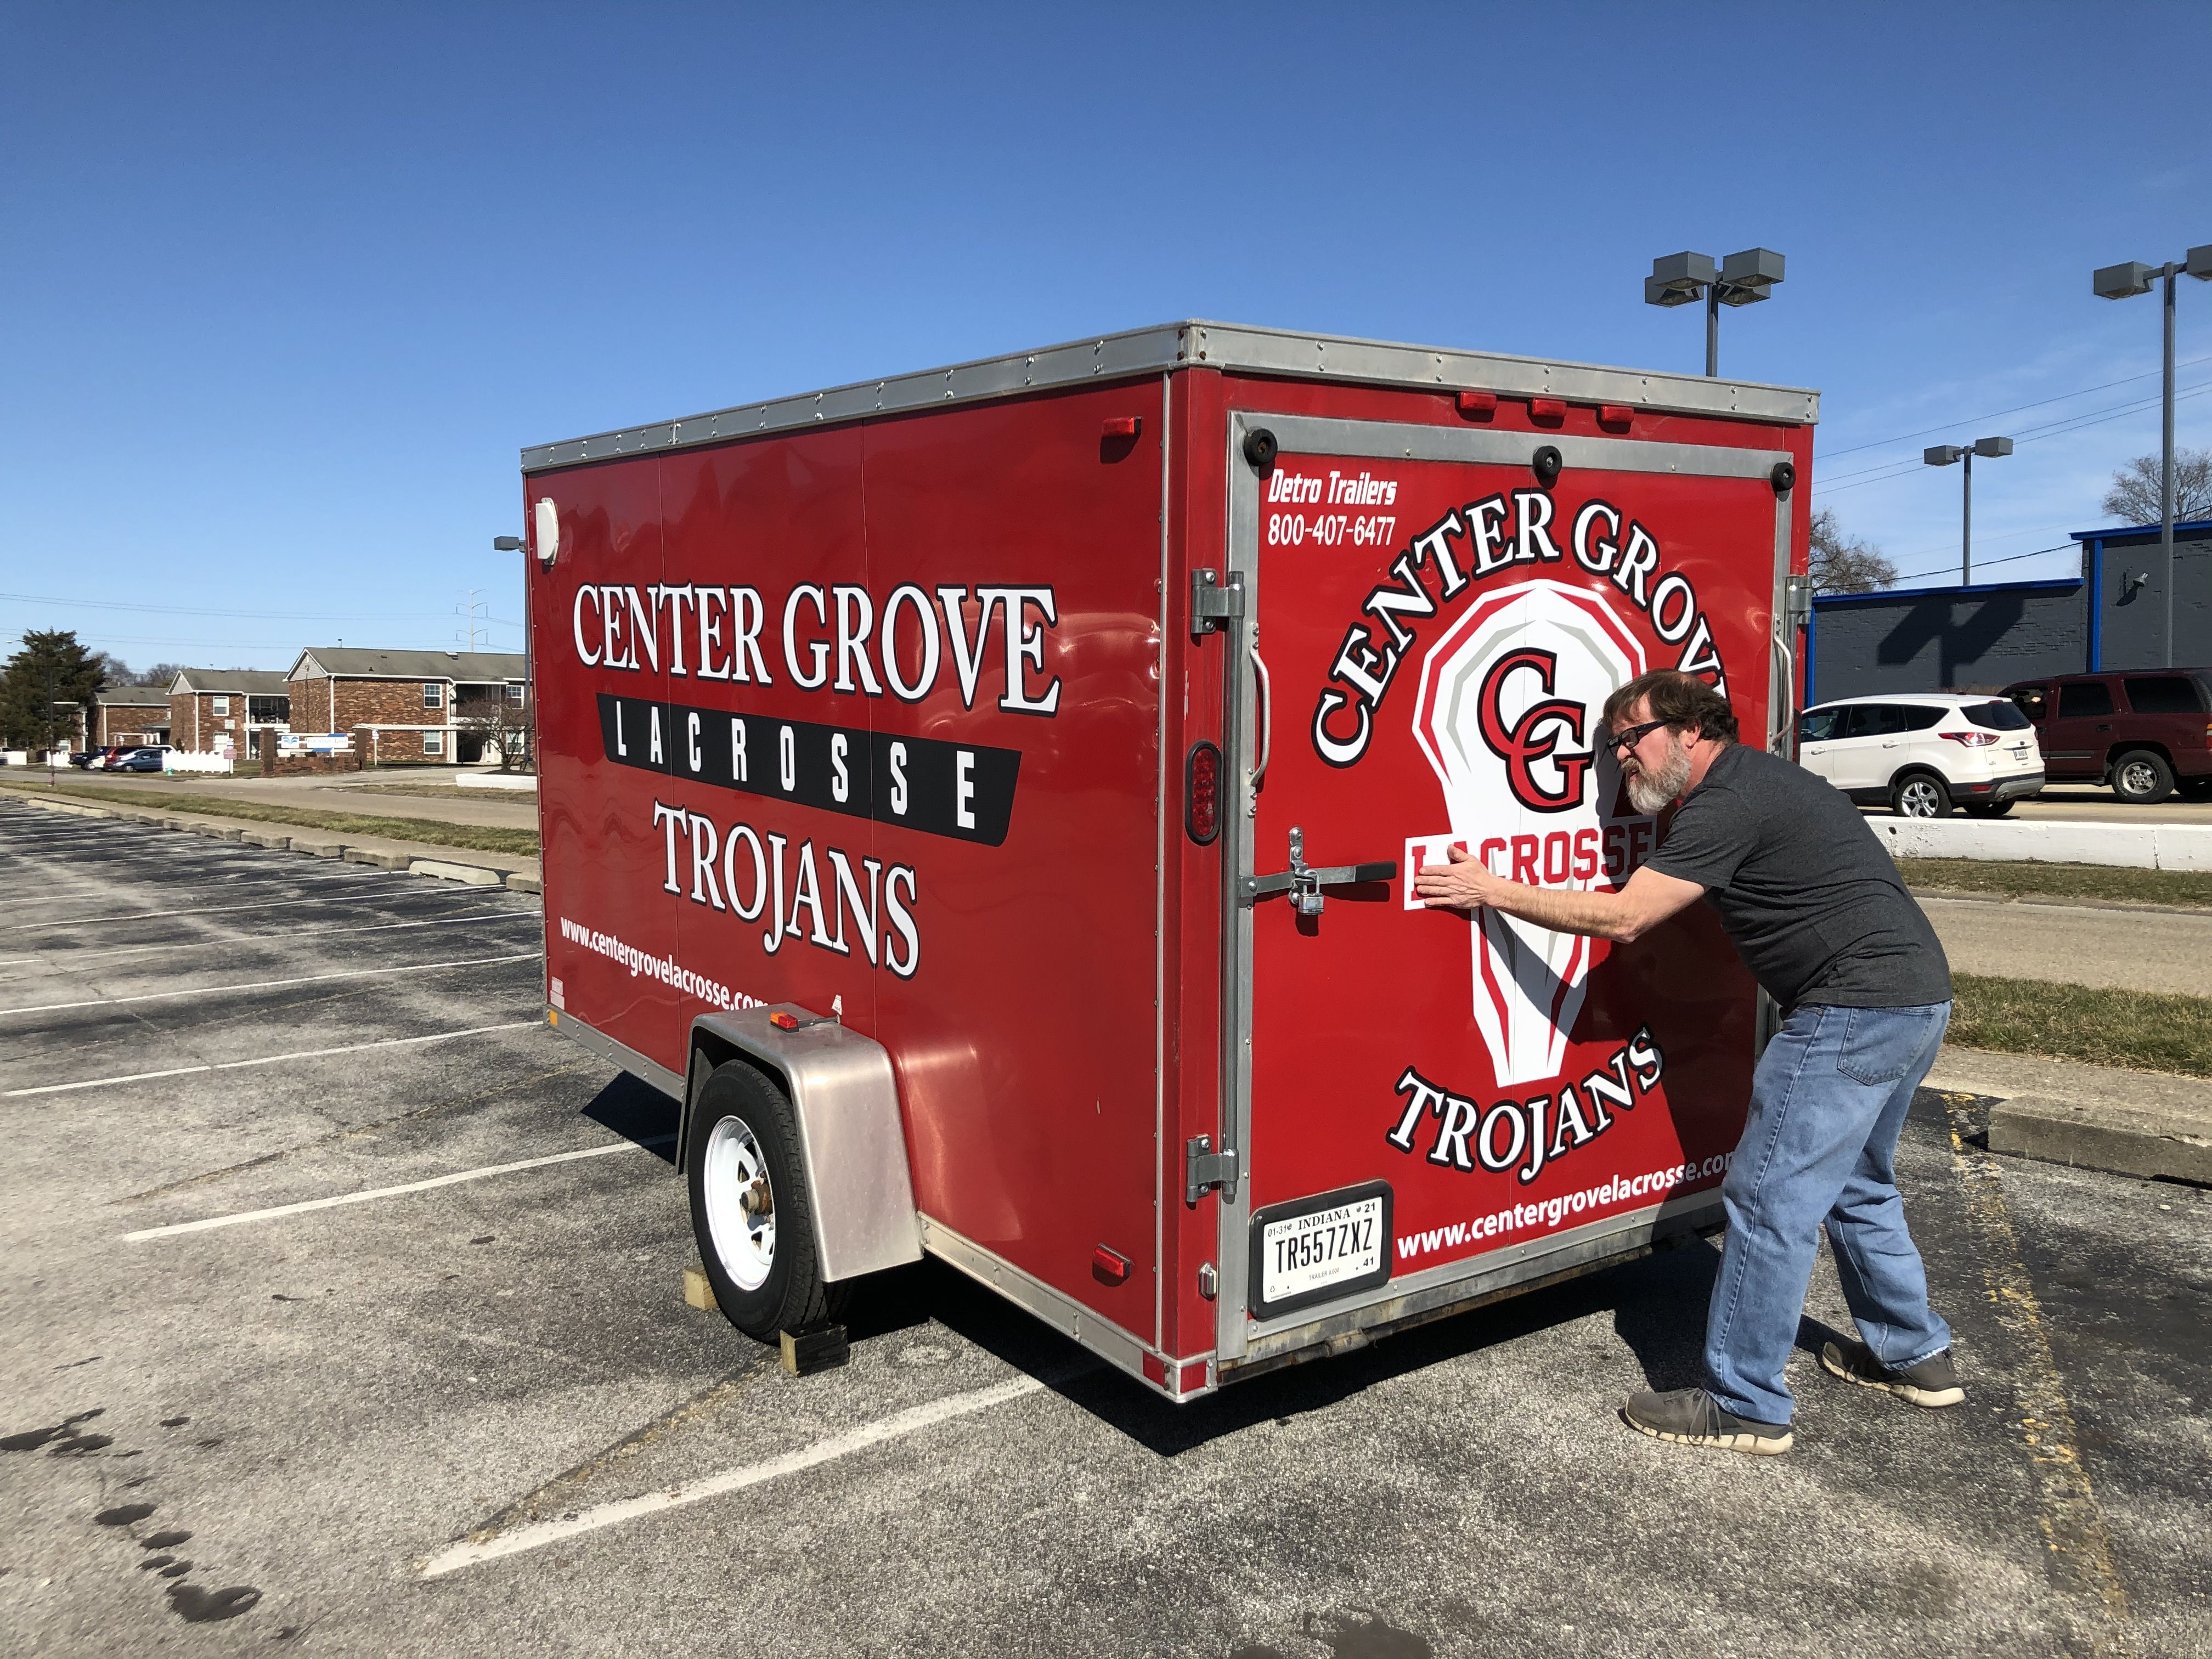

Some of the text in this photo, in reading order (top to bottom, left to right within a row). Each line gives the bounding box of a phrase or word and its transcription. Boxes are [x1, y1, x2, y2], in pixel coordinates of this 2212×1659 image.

[1267, 469, 1398, 505] Detro Trailers
[1267, 513, 1396, 546] 800-407-6477
[573, 580, 1061, 716] CENTER GROVE
[1311, 487, 1560, 768] CENTER
[614, 701, 975, 830] LACROSSE
[1477, 647, 1594, 813] CG
[653, 798, 921, 980] TROJANS
[1386, 1025, 1664, 1184] TROJANS
[1276, 1217, 1373, 1273] TR557ZXZ
[1298, 1208, 1351, 1231] INDIANA
[1364, 1202, 1375, 1214] 21
[1363, 1256, 1374, 1267] 41
[1308, 1271, 1328, 1282] TRAILER
